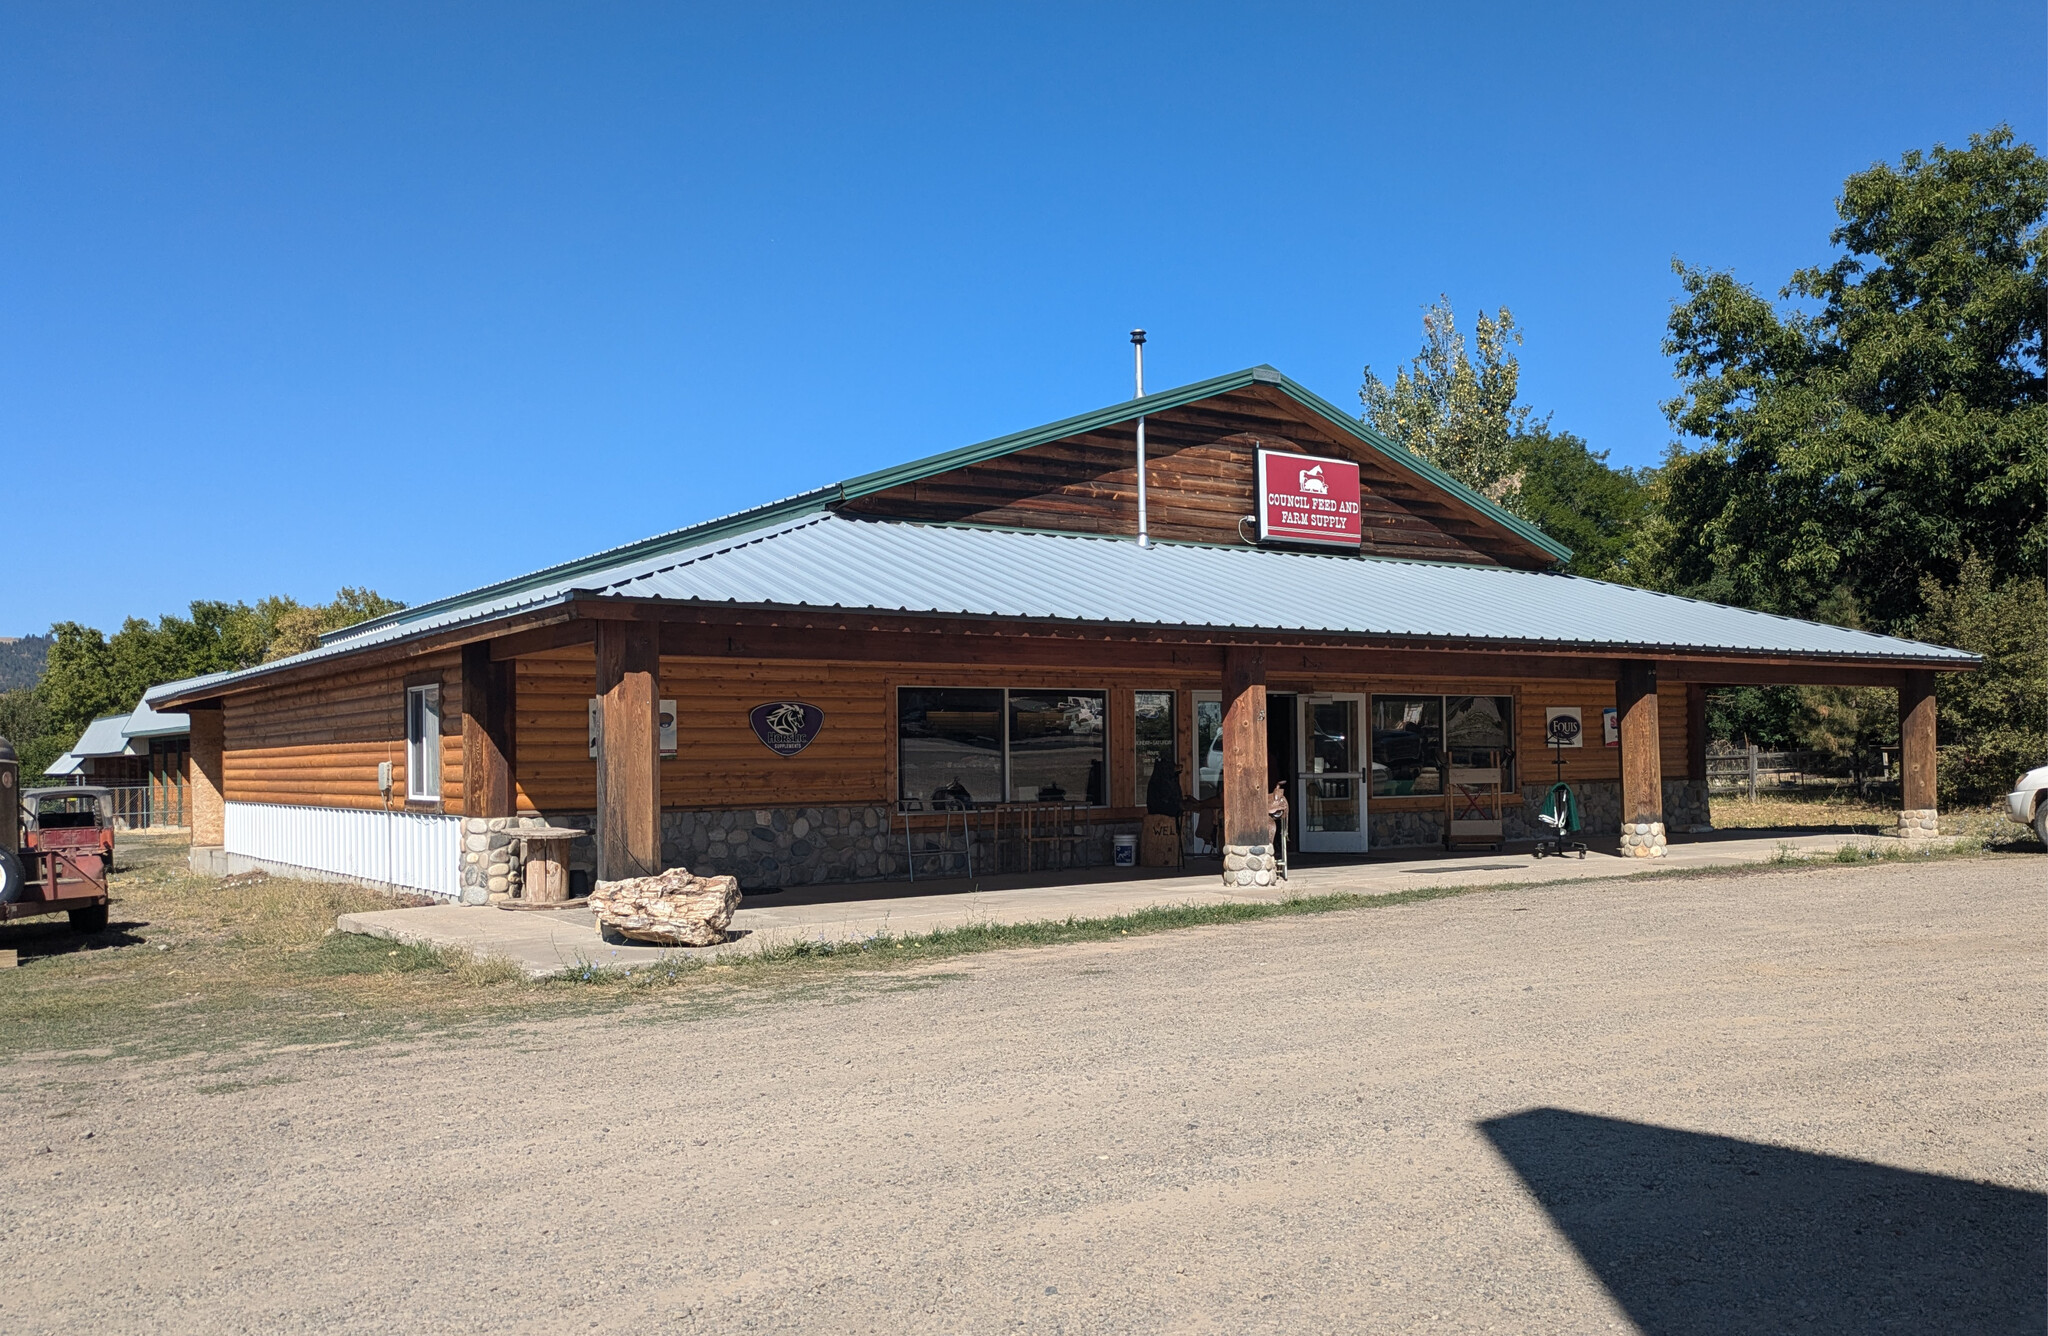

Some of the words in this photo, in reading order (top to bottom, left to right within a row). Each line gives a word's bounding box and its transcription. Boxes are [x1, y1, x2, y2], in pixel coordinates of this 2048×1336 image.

[1268, 493, 1310, 509] COUNCIL
[1312, 498, 1337, 512] FEED
[1339, 501, 1359, 514] AND
[1281, 511, 1308, 525] FARM
[1310, 514, 1347, 529] SUPPLY
